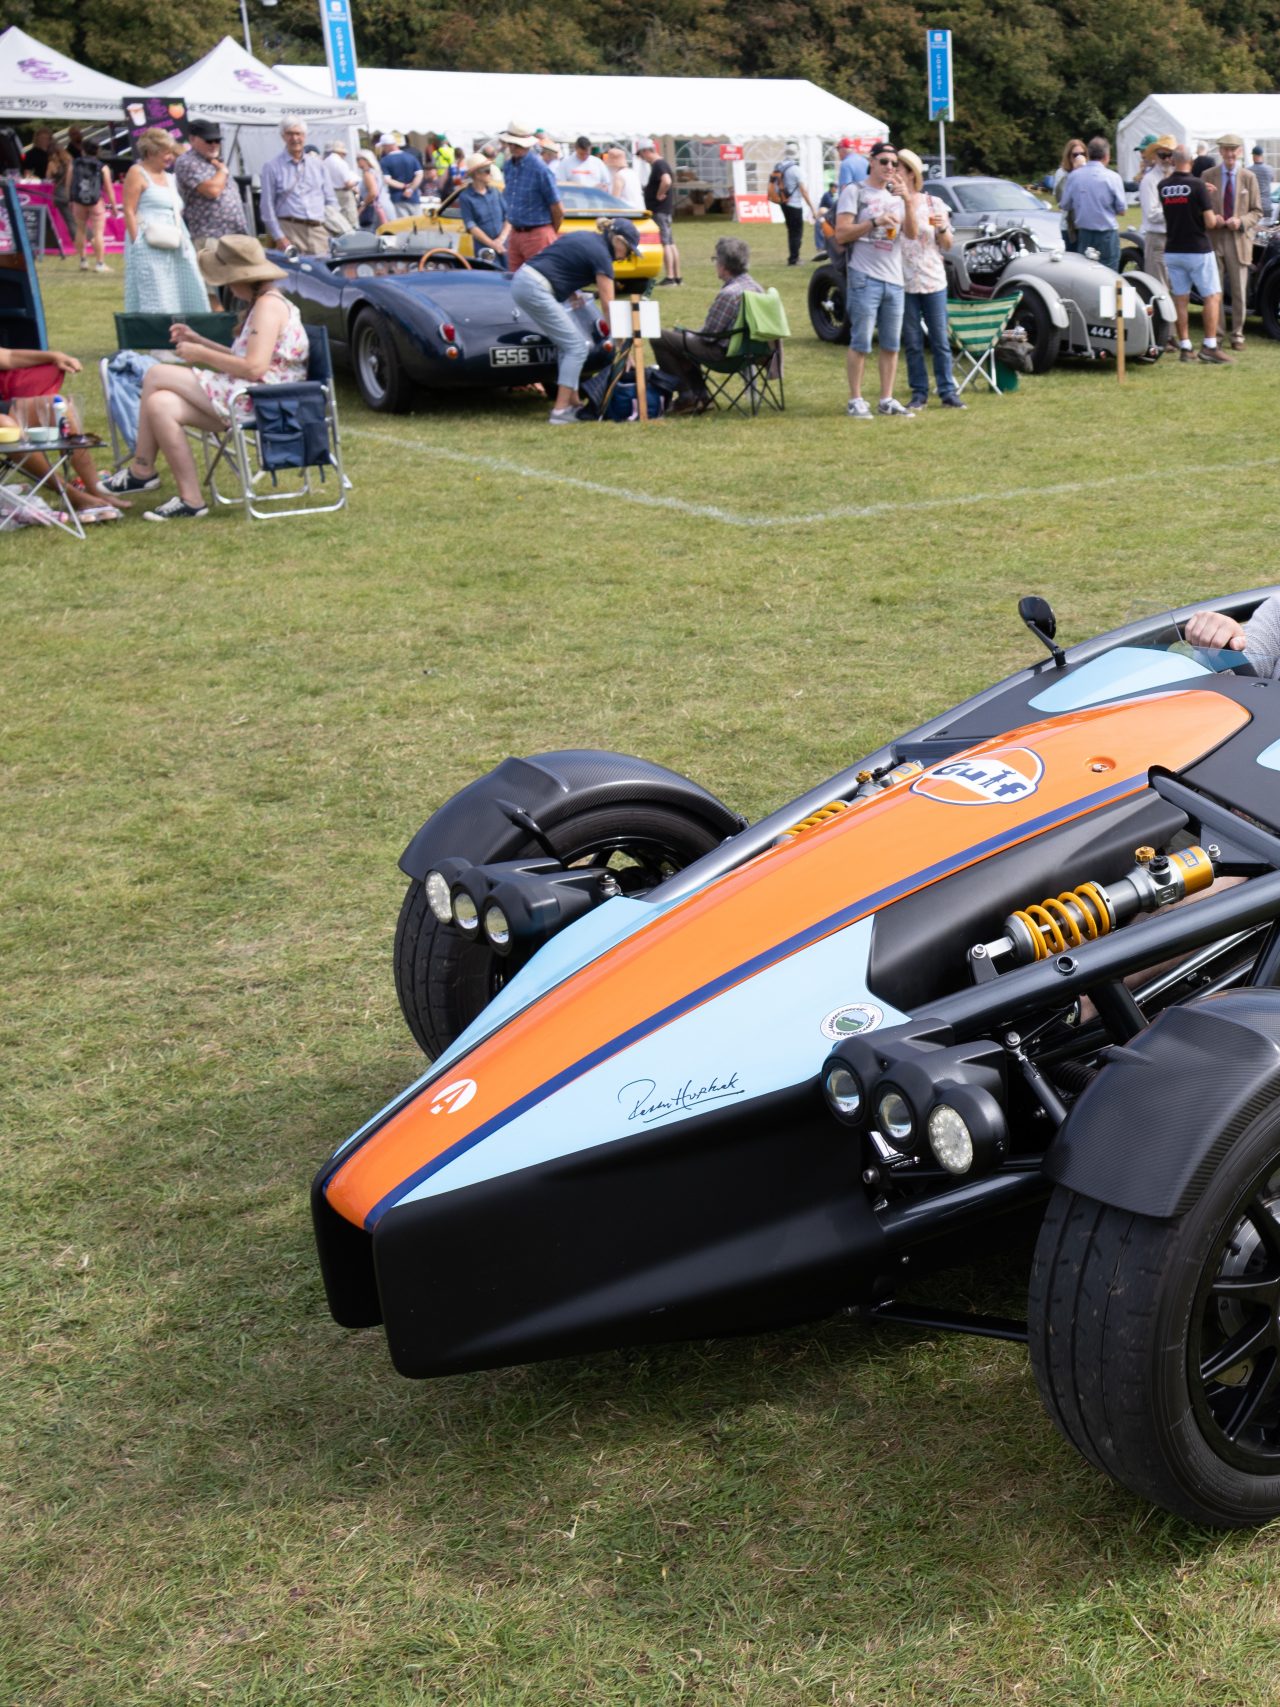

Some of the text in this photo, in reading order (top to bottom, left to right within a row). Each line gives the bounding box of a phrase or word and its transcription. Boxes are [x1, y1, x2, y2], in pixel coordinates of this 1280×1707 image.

[18, 98, 48, 110] Stop
[199, 103, 237, 114] Coffee
[240, 104, 267, 115] Stop
[738, 200, 770, 218] Exit
[1090, 326, 1111, 338] 444
[495, 347, 558, 364] 556 VM
[932, 762, 1028, 798] Gulf
